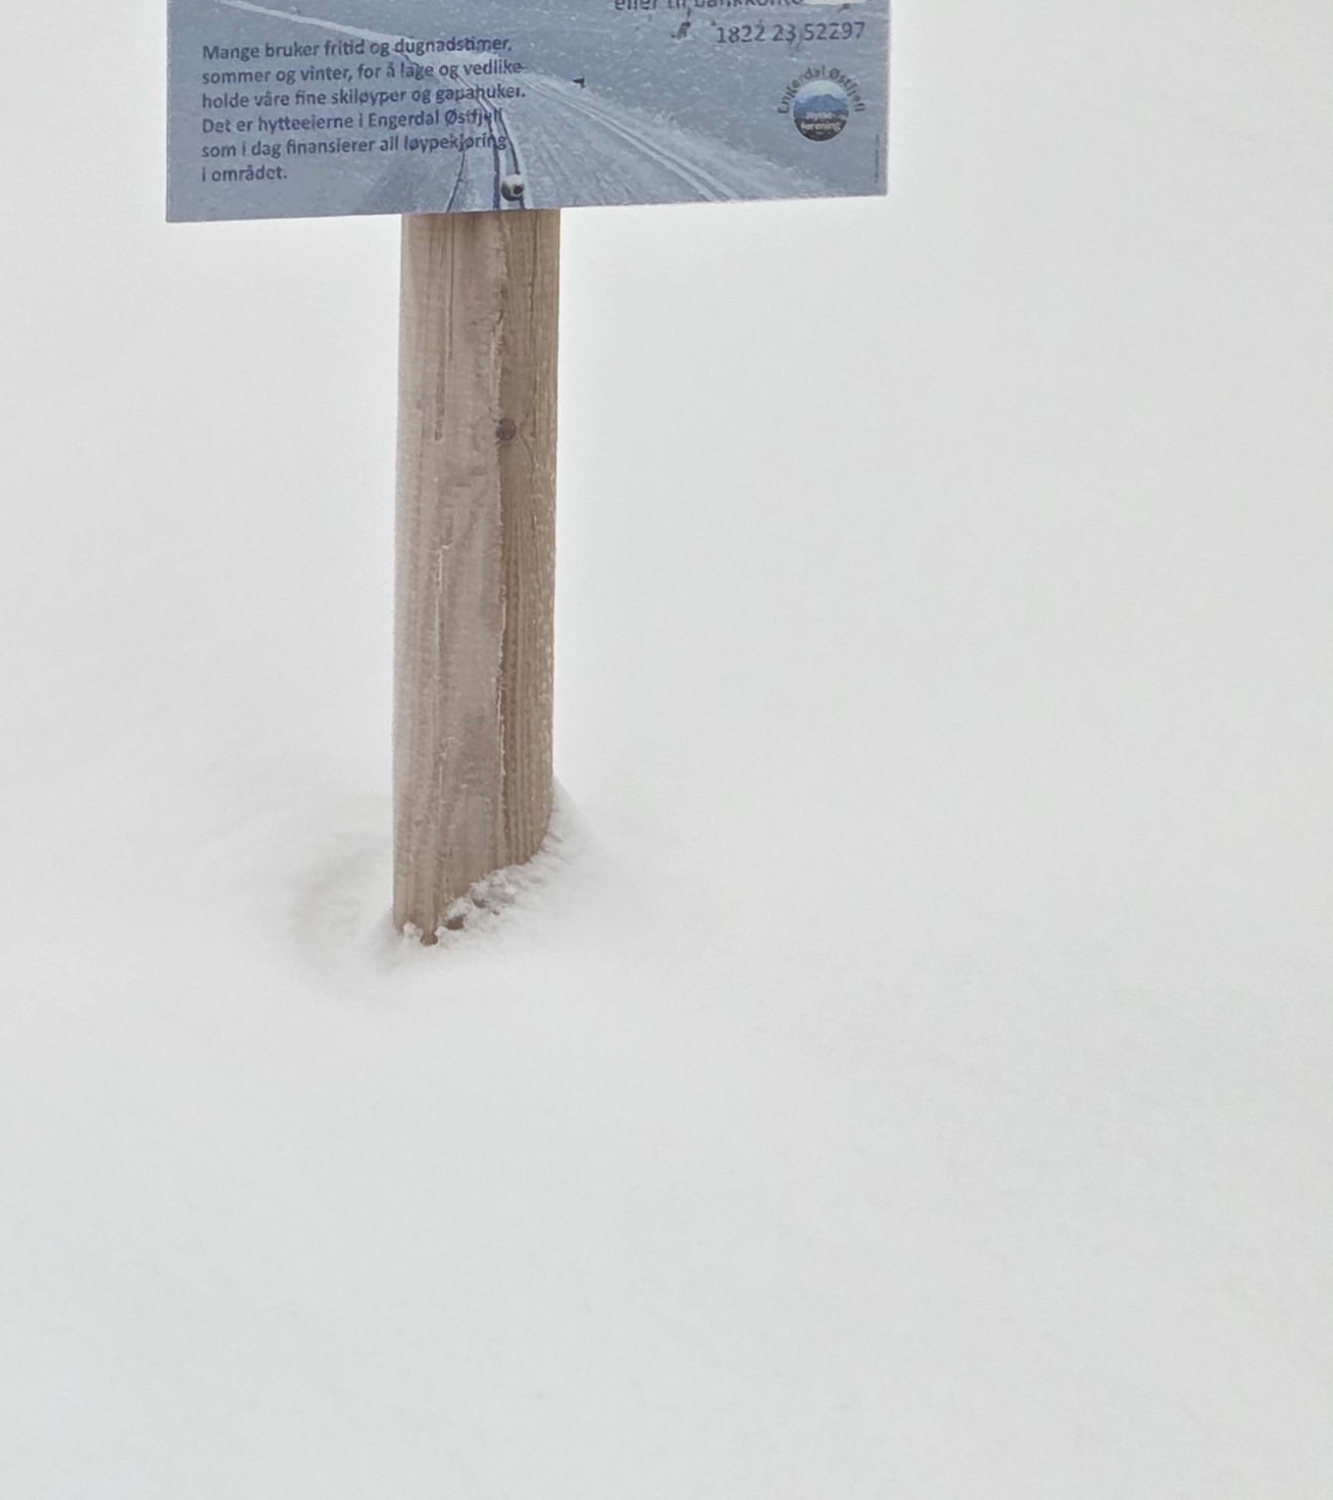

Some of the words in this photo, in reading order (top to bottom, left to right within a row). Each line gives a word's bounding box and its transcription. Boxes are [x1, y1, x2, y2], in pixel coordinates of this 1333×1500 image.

[716, 23, 766, 44] 1822
[772, 23, 797, 43] 23
[804, 21, 866, 42] 52297
[202, 44, 260, 63] Mange
[264, 41, 320, 58] bruker
[323, 39, 365, 56] fritid
[369, 41, 390, 57] og
[201, 68, 271, 84] sommer
[275, 68, 296, 85] og
[300, 65, 353, 83] vinter,
[357, 63, 381, 79] for
[386, 61, 396, 79] å
[400, 63, 434, 82] lage
[438, 63, 459, 80] og
[201, 93, 250, 110] holde
[253, 89, 290, 107] våre
[294, 88, 326, 106] fine
[330, 86, 407, 106] skiløyper
[411, 88, 431, 104] og
[201, 117, 232, 134] Det
[236, 117, 254, 132] er
[258, 112, 354, 135] hytteeierne
[358, 112, 363, 128] i
[368, 108, 439, 130] Engerdal
[444, 106, 503, 127] Østfjell
[201, 144, 237, 158] som
[241, 140, 246, 156] i
[250, 139, 281, 160] dag
[286, 136, 376, 155] finansierer
[379, 133, 400, 152] all
[403, 132, 508, 152] løypekjøring
[201, 166, 206, 183] i
[211, 161, 288, 182] området.
